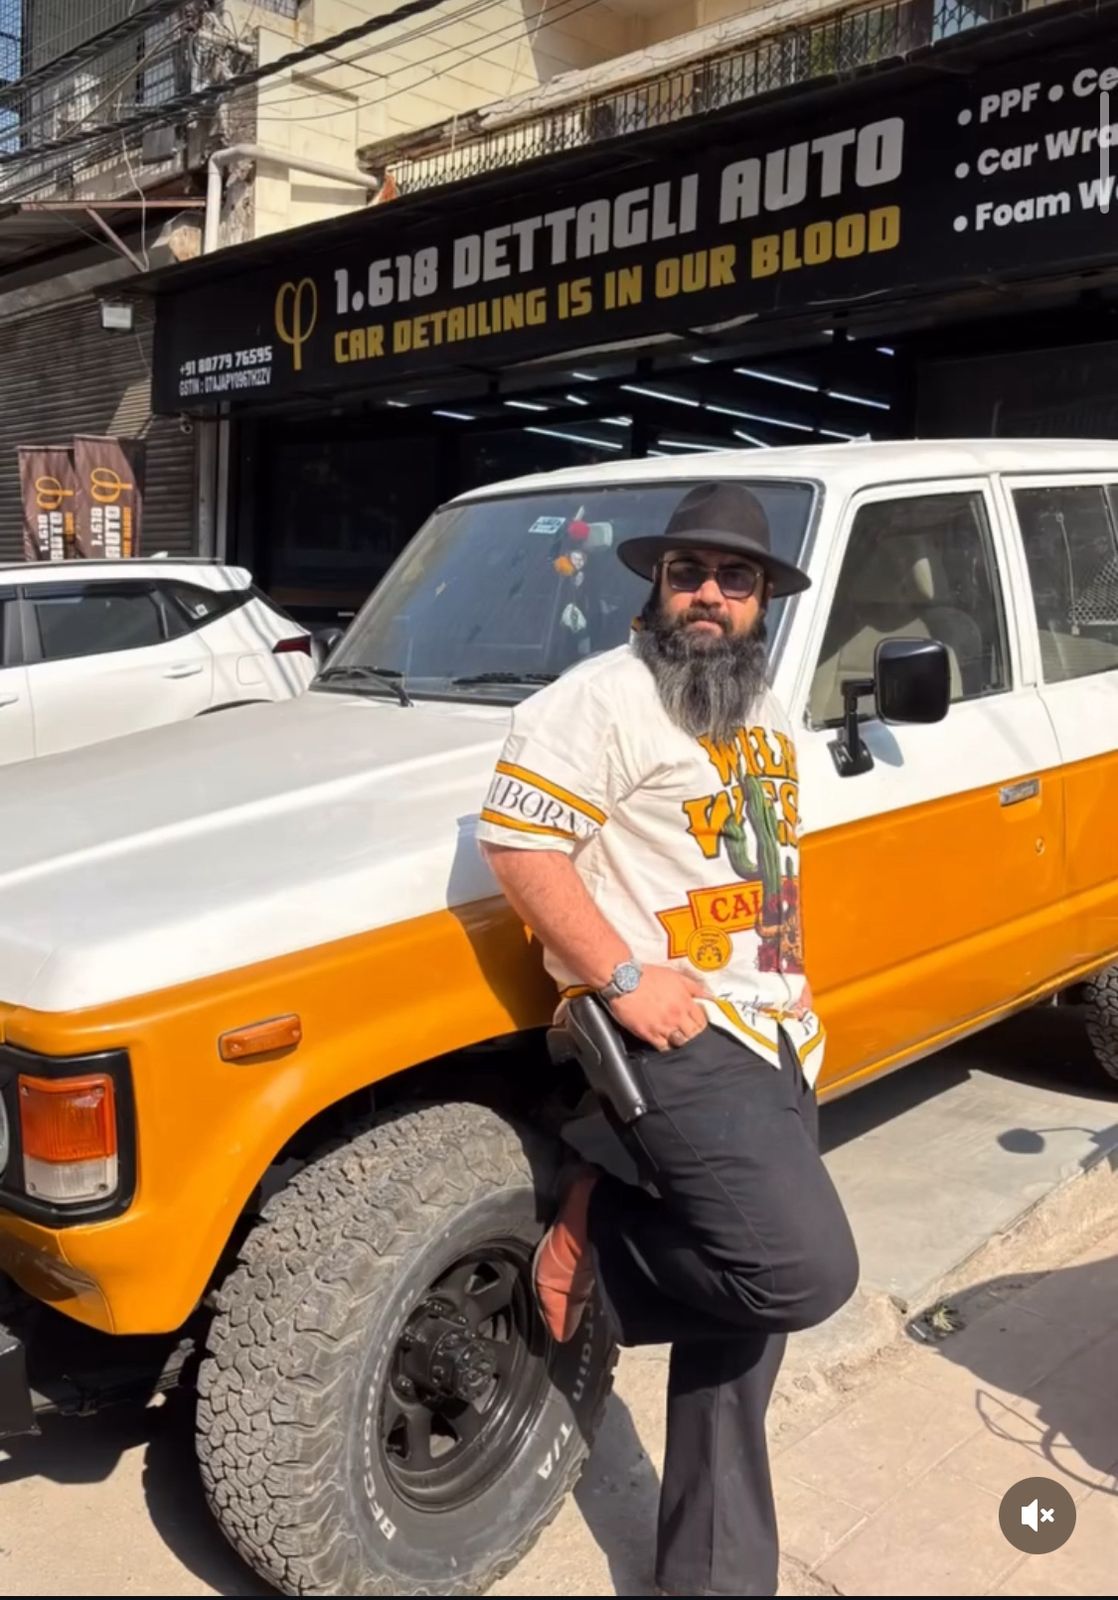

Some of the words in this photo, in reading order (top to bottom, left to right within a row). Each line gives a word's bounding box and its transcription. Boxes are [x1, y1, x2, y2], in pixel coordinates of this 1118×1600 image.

[979, 82, 1041, 123] PPF
[1072, 66, 1118, 97] Ce
[977, 142, 1039, 177] Car
[1045, 122, 1118, 161] Wra
[334, 246, 438, 314] 1.618
[453, 173, 698, 290] DETTAGLI
[719, 117, 904, 224] AUTO
[976, 191, 1071, 231] Foam
[334, 328, 384, 364] CAR
[393, 287, 547, 354] DETAILING
[558, 276, 593, 320] IS
[605, 264, 642, 310] IN
[655, 244, 736, 299] OUR
[751, 205, 900, 279] BLOOD
[180, 360, 197, 376] +91
[235, 346, 273, 367] 76595
[537, 1422, 574, 1480] T/A
